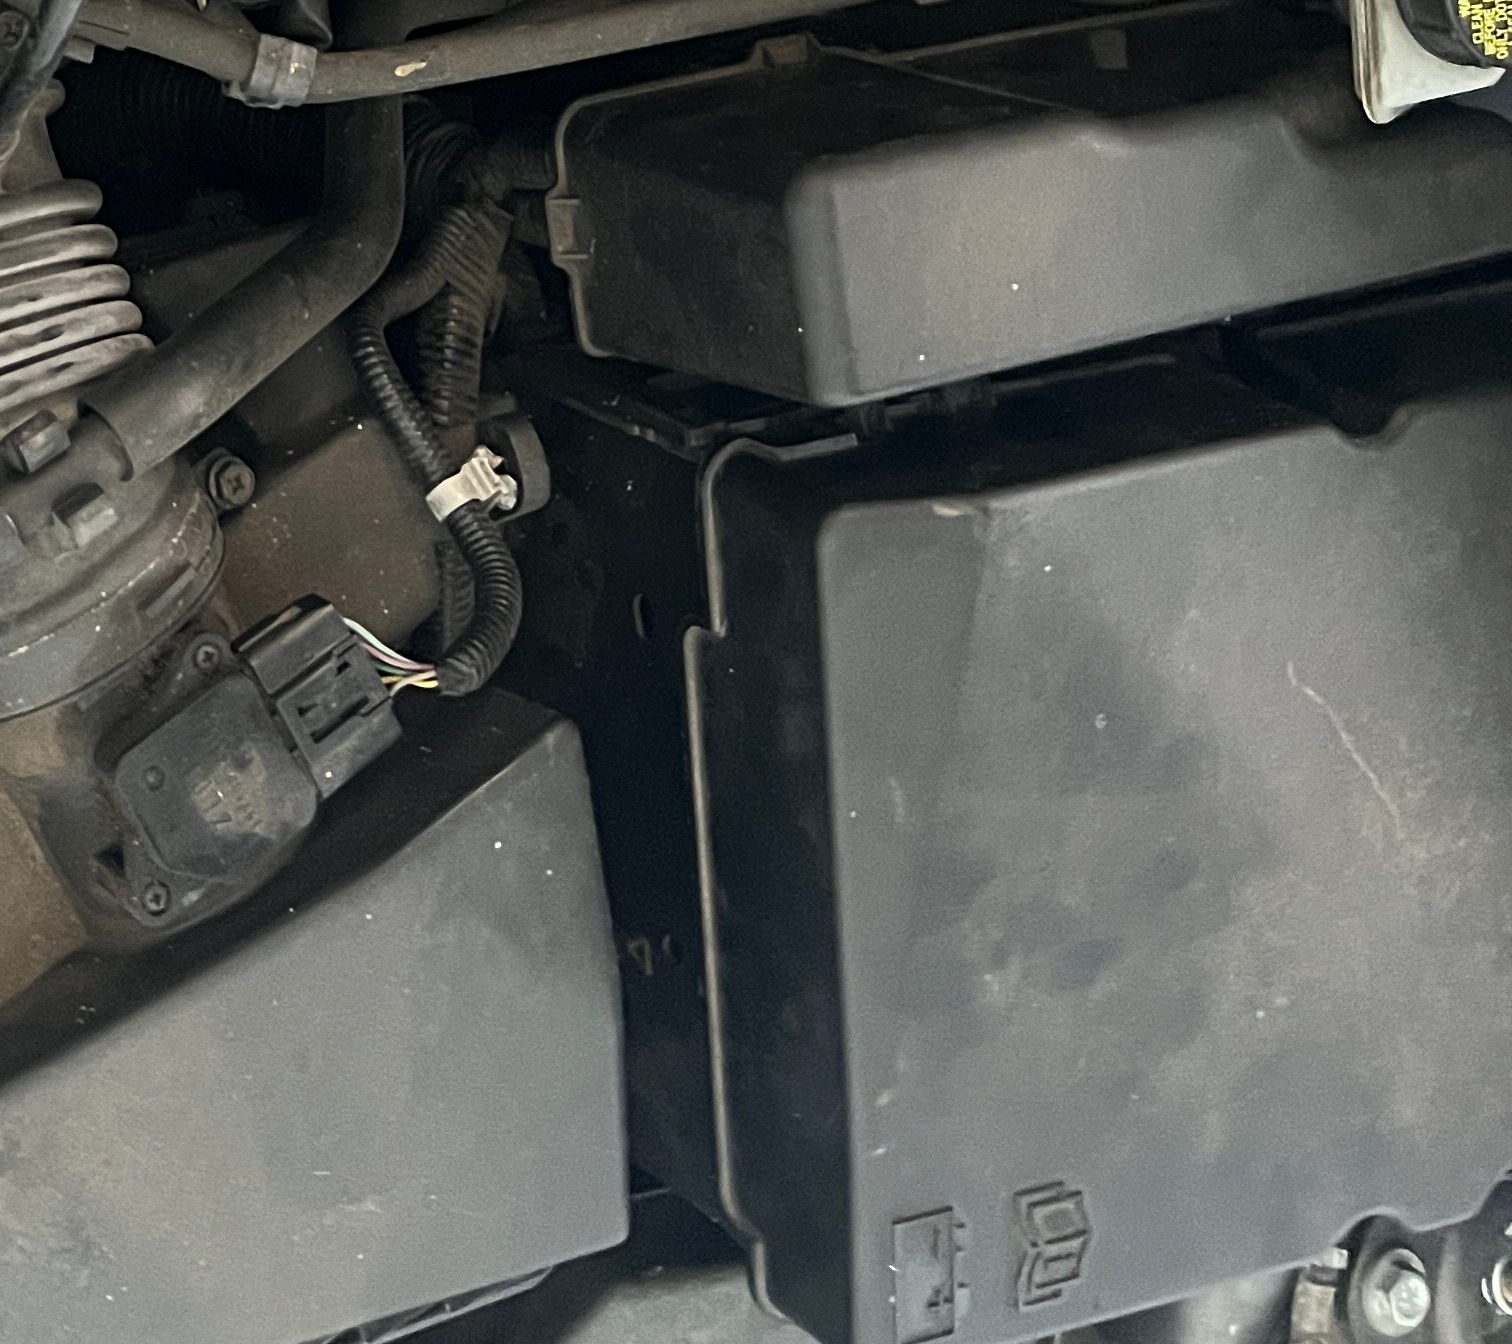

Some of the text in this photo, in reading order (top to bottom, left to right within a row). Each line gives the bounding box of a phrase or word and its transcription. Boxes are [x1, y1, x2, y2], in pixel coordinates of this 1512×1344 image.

[1471, 4, 1484, 44] CLEAN
[1483, 8, 1496, 55] BEFORE
[1495, 28, 1509, 59] ONLY
